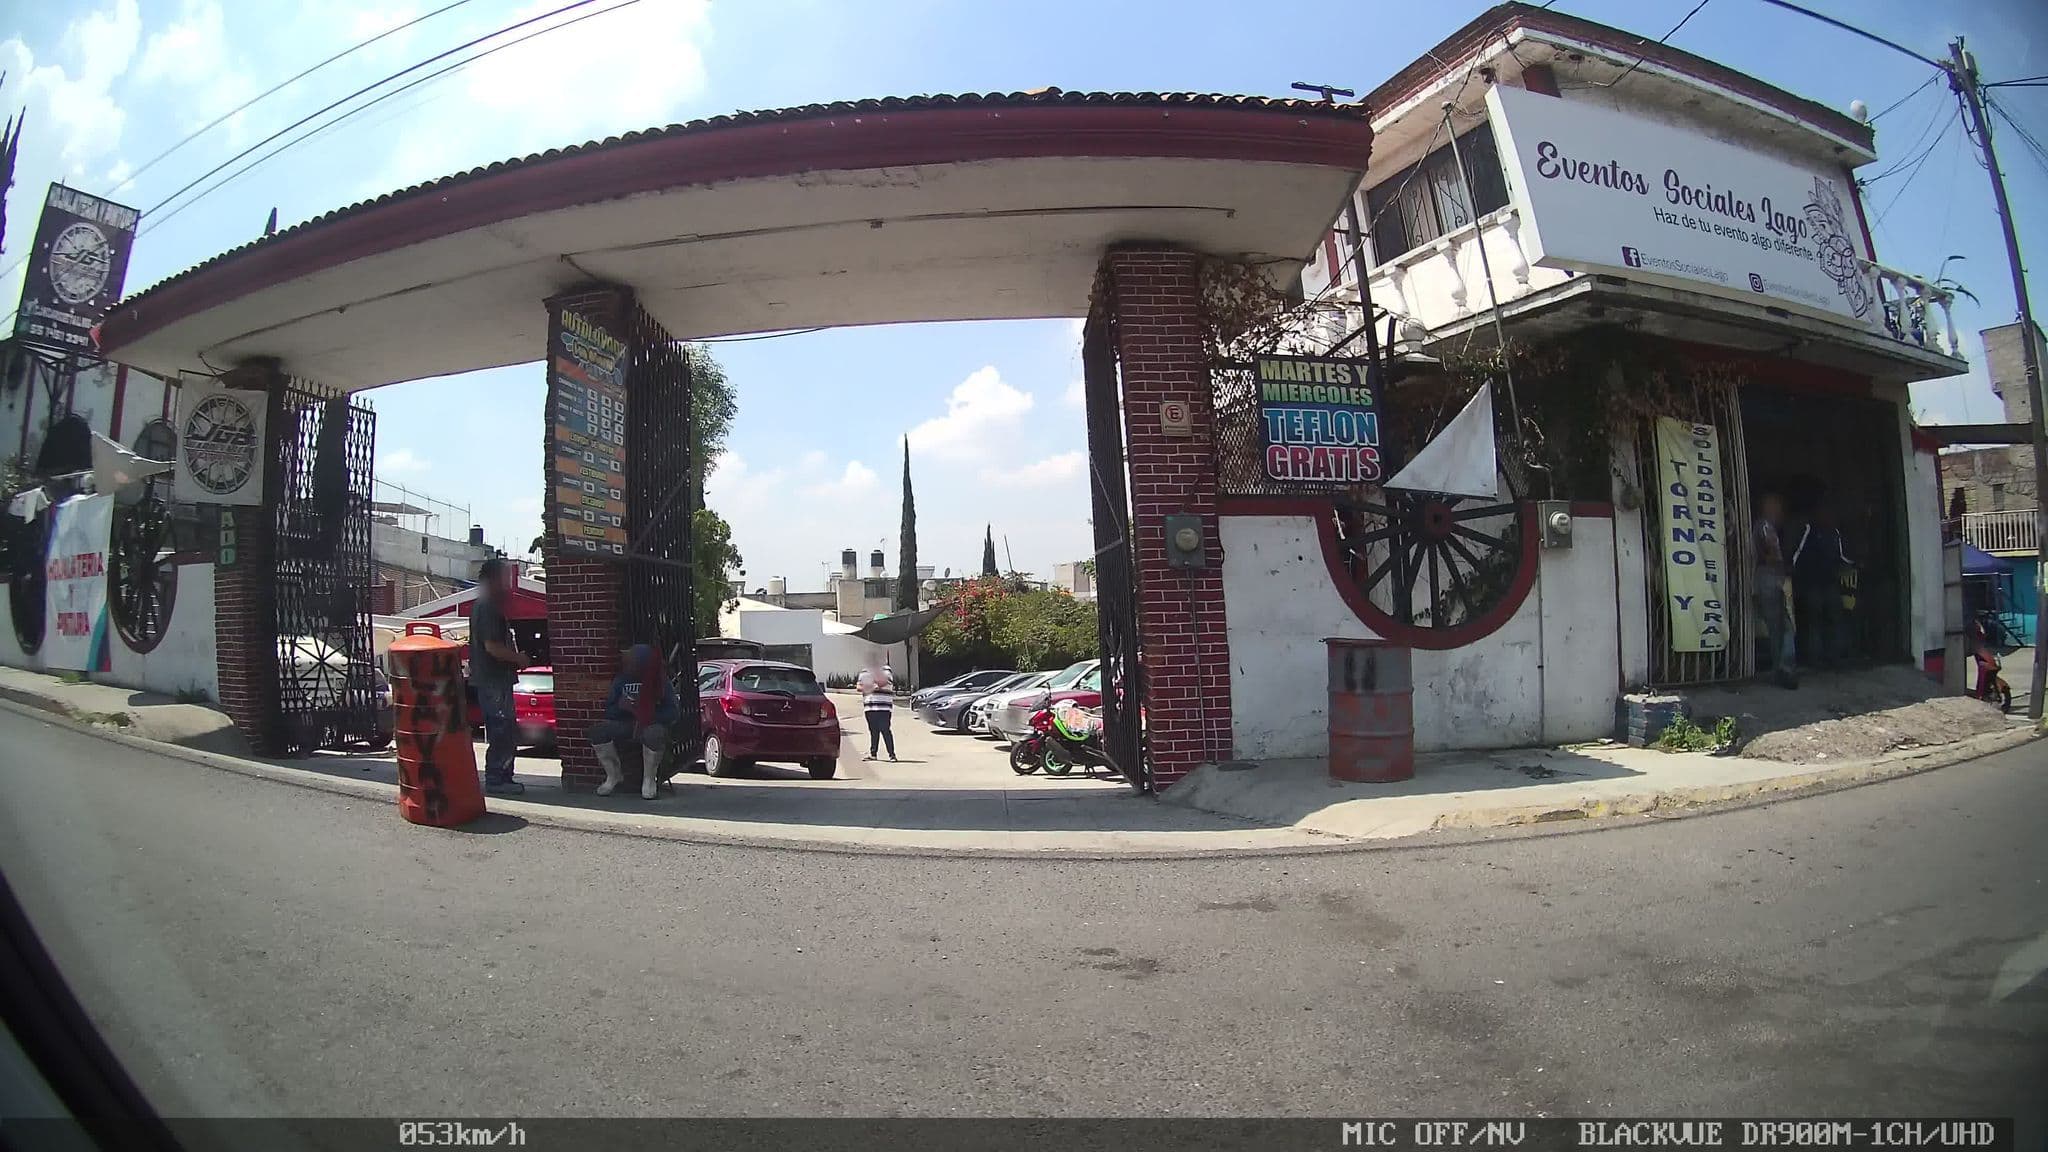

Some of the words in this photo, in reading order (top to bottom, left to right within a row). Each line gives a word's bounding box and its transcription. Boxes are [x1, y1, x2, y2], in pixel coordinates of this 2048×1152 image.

[1537, 141, 1649, 195] Eventos
[1664, 169, 1756, 223] Sociales
[1761, 197, 1807, 244] Lago
[1653, 206, 1678, 226] Haz
[1681, 213, 1697, 230] de
[1699, 217, 1711, 233] tu
[1714, 223, 1749, 243] evento
[1751, 232, 1772, 251] algo
[1260, 360, 1351, 385] MARTES
[1355, 365, 1368, 385] Y
[1262, 383, 1373, 406] MIERCOLES
[1262, 408, 1379, 446] TEFLON
[1267, 445, 1381, 481] GRATIS
[1670, 460, 1697, 566] TORNO
[1692, 426, 1716, 543] SOLDADURA
[1704, 560, 1717, 583] EN
[1673, 595, 1694, 611] Y
